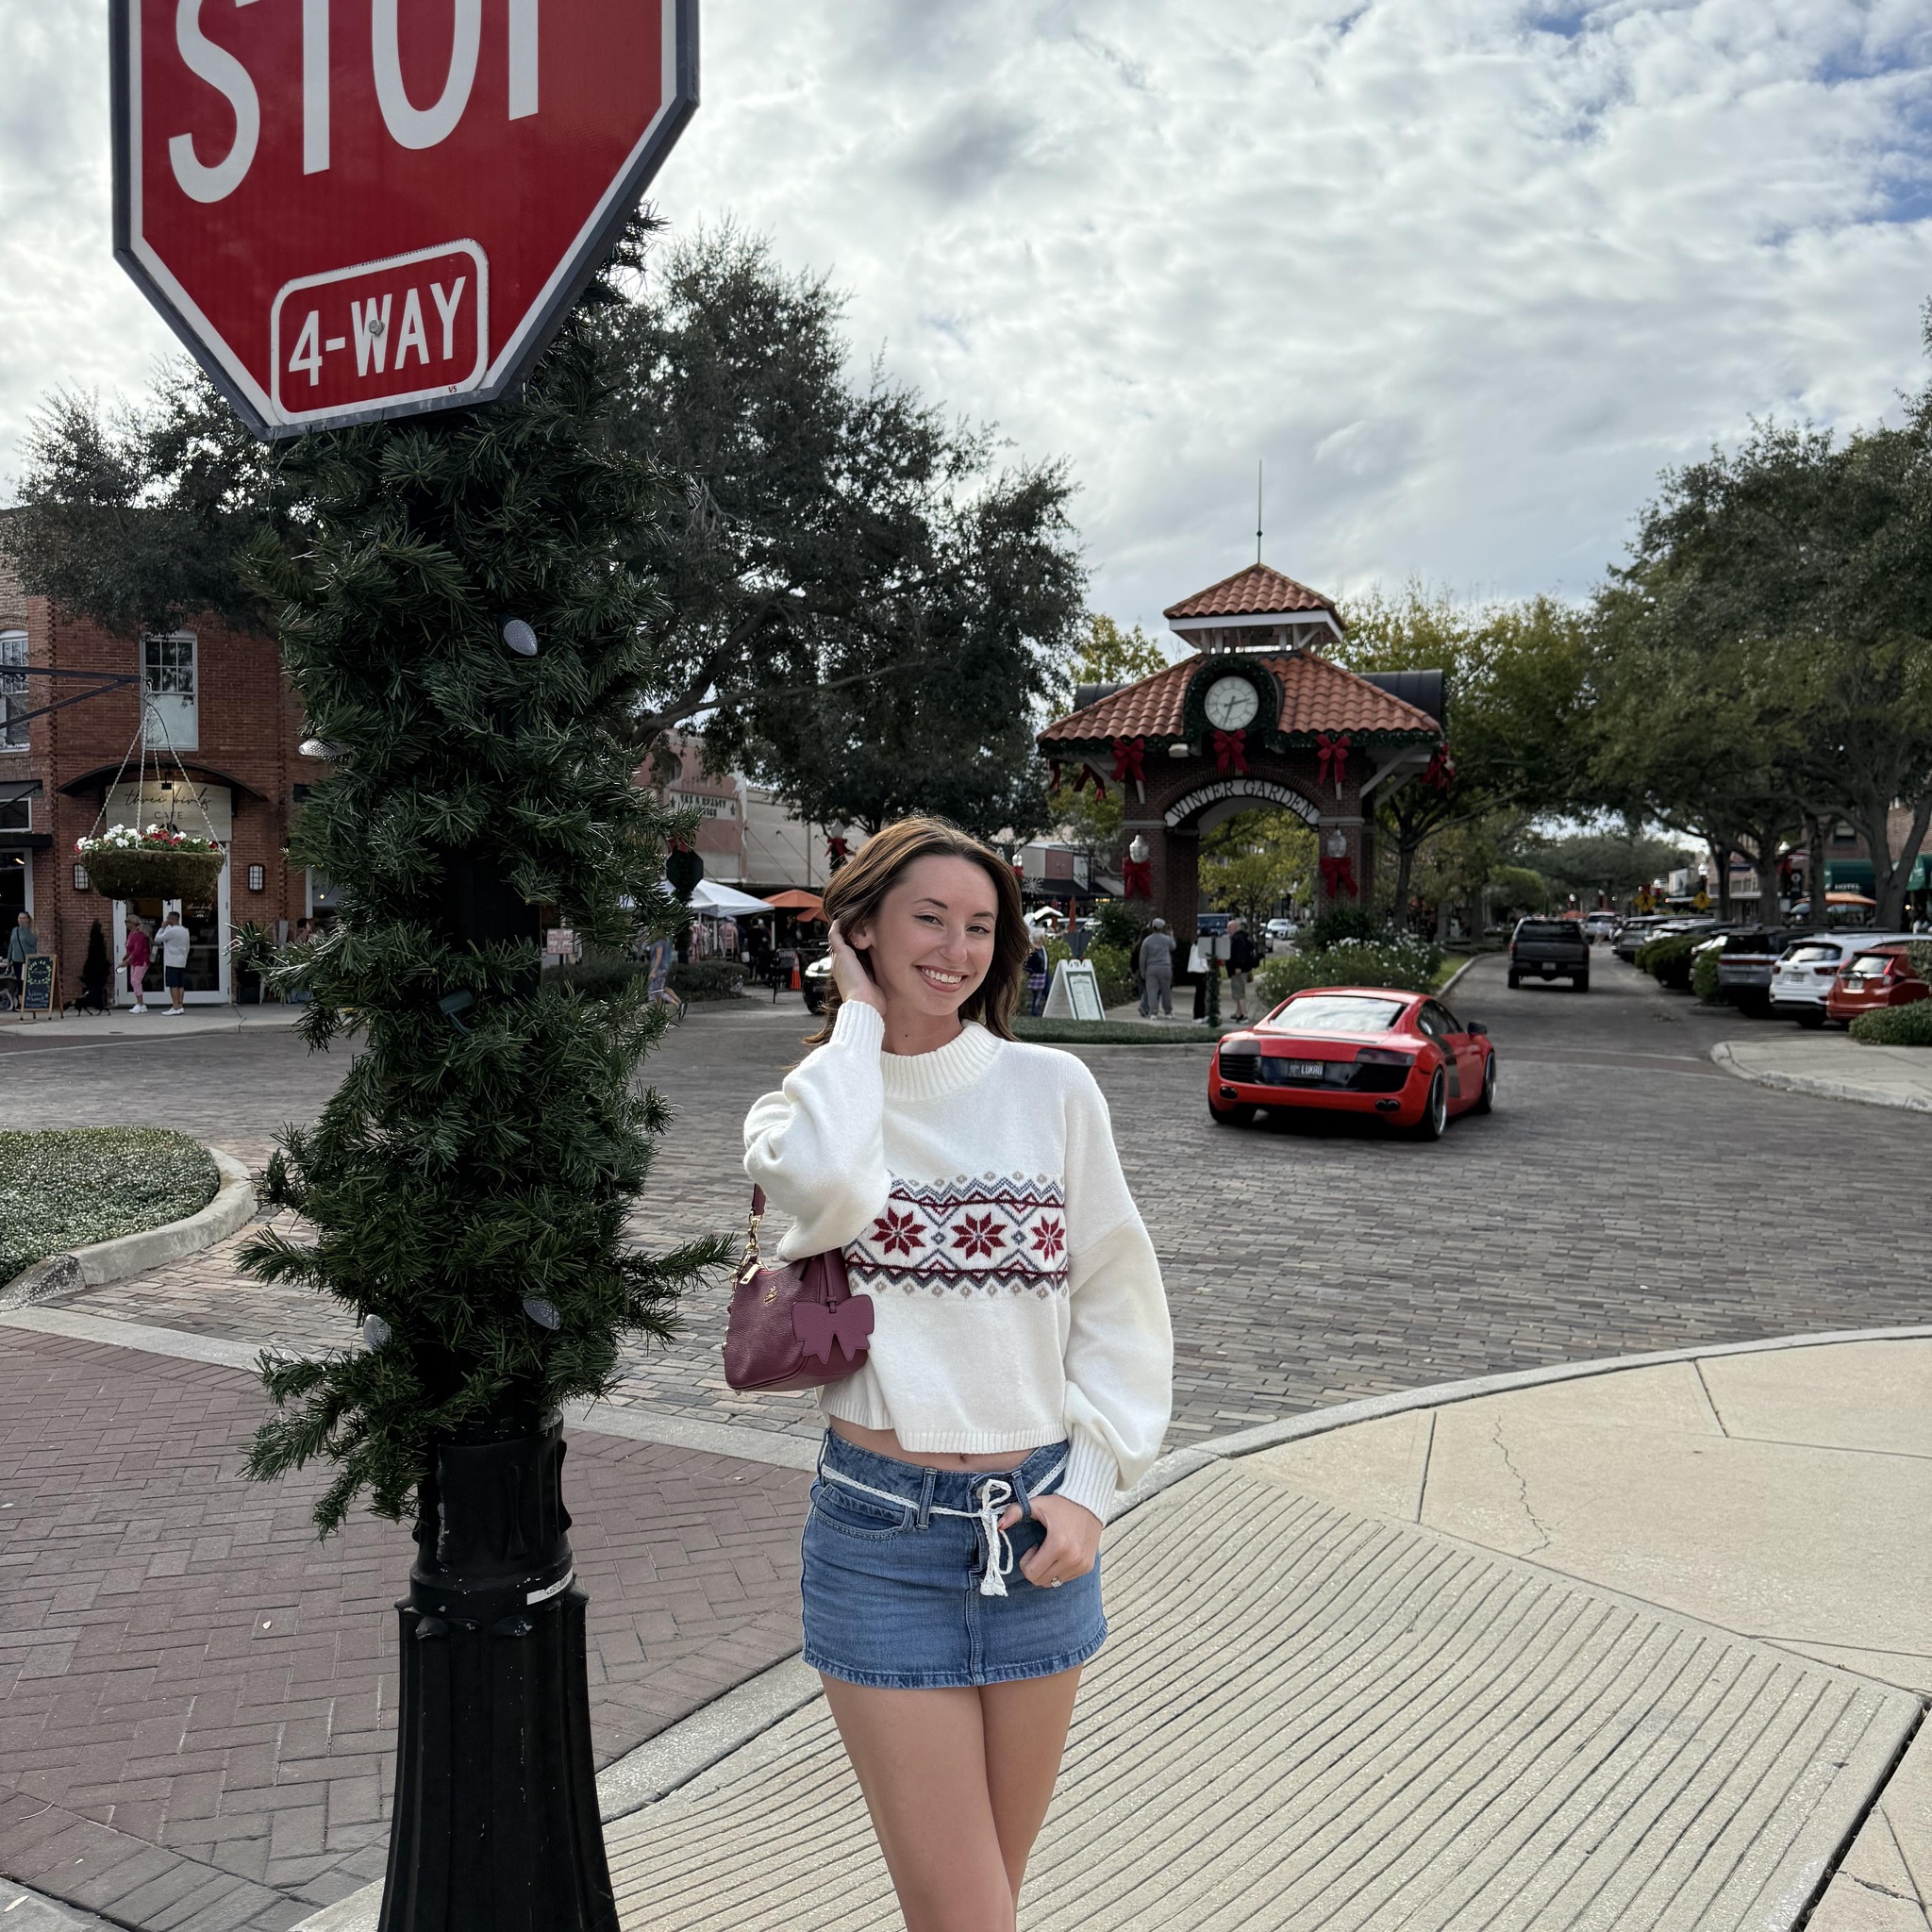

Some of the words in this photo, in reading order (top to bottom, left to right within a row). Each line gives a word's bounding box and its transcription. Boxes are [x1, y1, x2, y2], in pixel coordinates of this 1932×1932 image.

[288, 275, 467, 387] 4-WAY
[1171, 779, 1234, 820] WINTER
[1243, 779, 1315, 820] GARDEN
